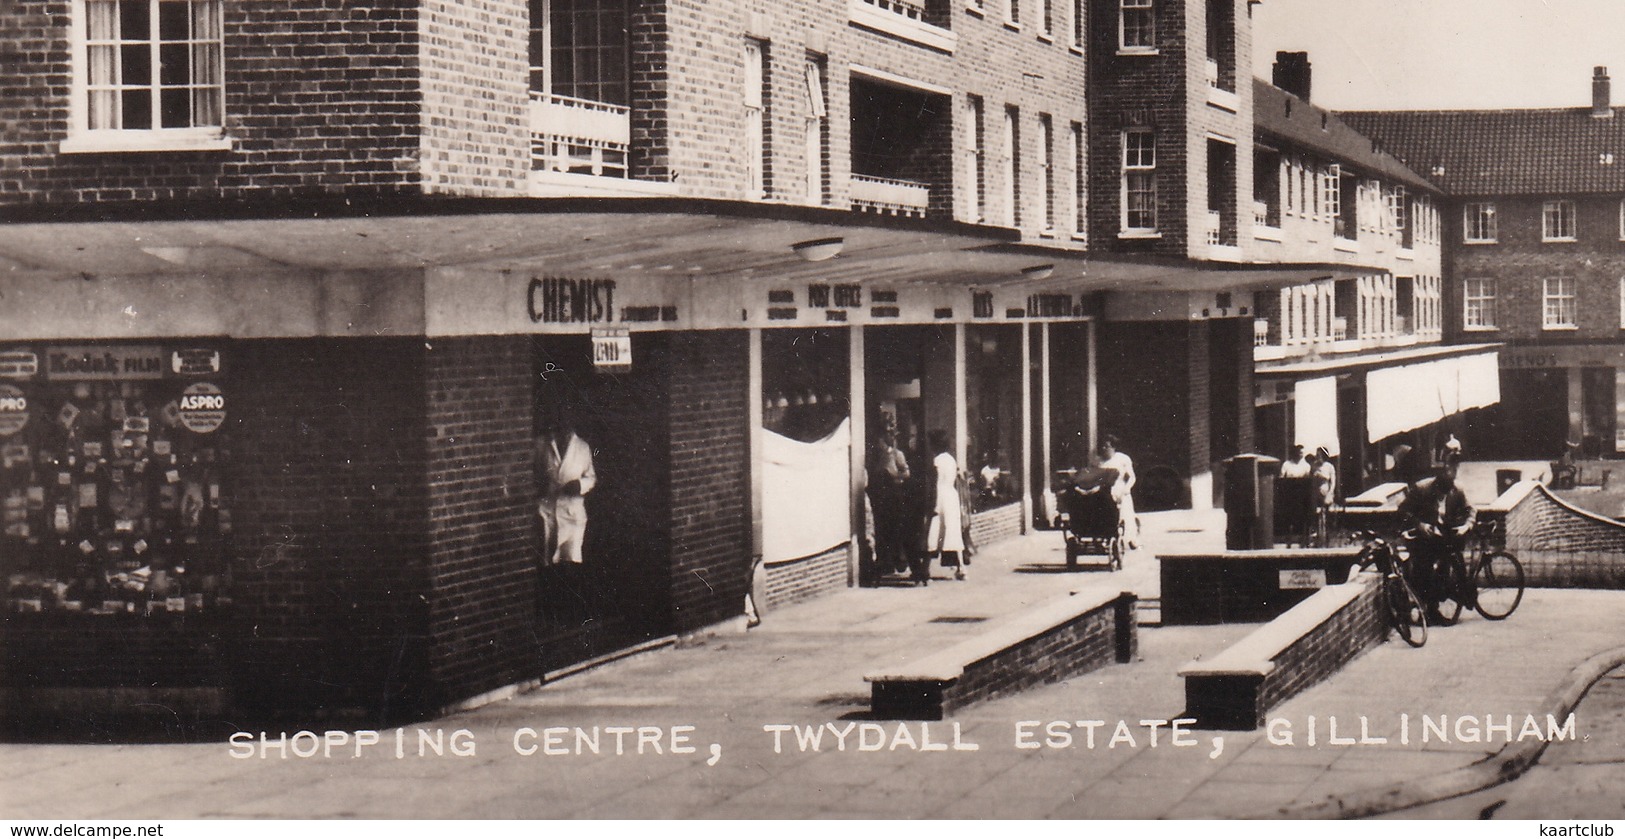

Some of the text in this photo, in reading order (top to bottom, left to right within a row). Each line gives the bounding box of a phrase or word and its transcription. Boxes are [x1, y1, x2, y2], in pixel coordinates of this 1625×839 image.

[527, 277, 616, 323] CHEMIST
[124, 357, 161, 372] FILM
[180, 395, 225, 410] ASPRO
